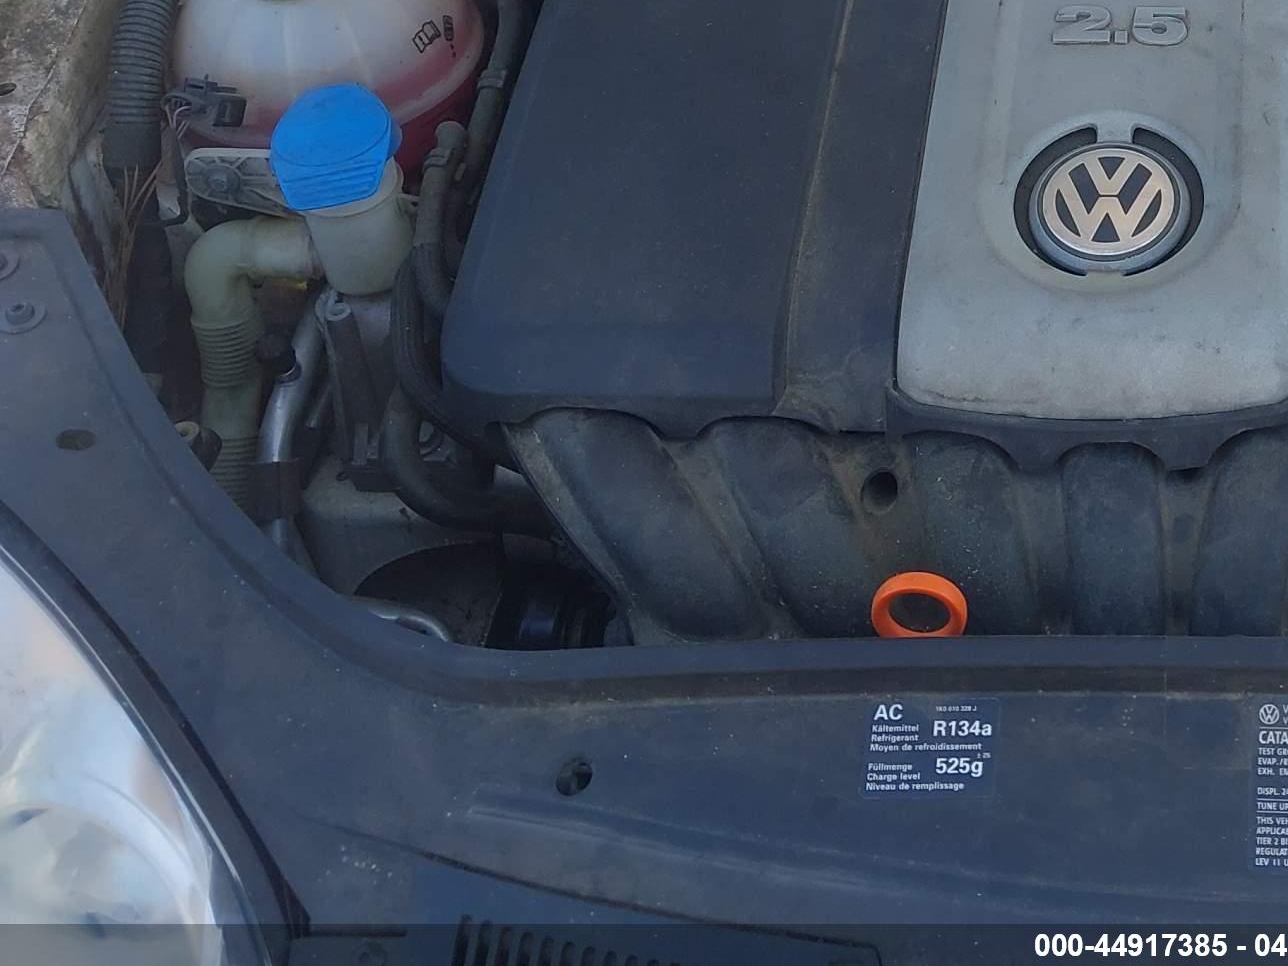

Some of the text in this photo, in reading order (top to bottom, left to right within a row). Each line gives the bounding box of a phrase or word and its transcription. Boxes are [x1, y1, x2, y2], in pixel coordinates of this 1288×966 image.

[1051, 4, 1188, 46] 2.5
[874, 704, 903, 720] AC
[872, 724, 919, 732] Kältemittel
[933, 721, 992, 736] R134a
[871, 734, 919, 743] Refrigerant
[870, 744, 899, 753] Moyen
[902, 743, 912, 751] de
[1258, 748, 1275, 756] TEST
[868, 763, 912, 772] Füllmenge
[936, 758, 983, 777] 525g
[1258, 768, 1275, 776] EXH.
[867, 773, 898, 782] Charge
[866, 782, 964, 792] Niveau de remplissage
[1257, 817, 1273, 825] THIS
[1256, 858, 1270, 866] LEV
